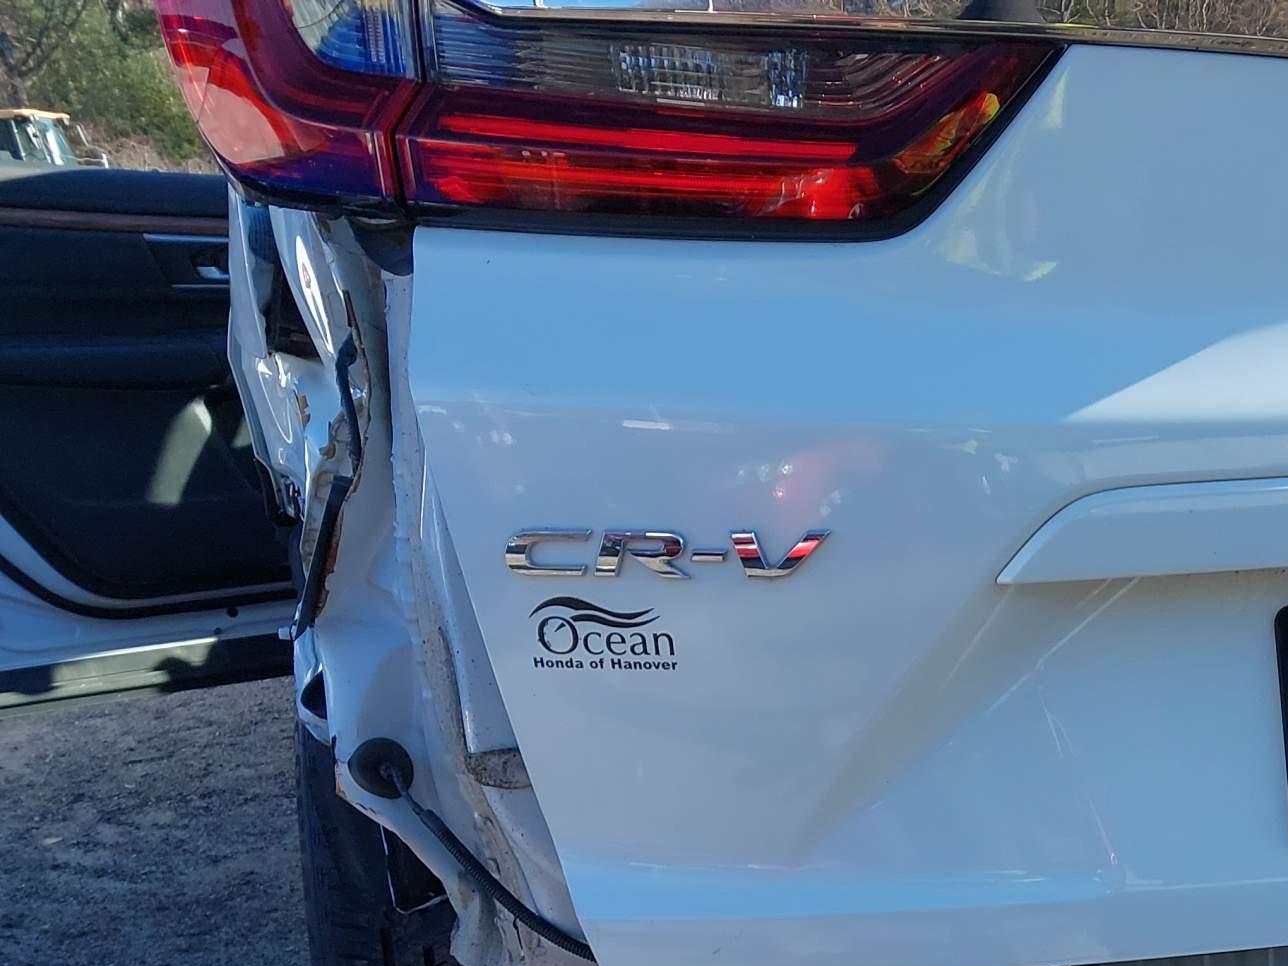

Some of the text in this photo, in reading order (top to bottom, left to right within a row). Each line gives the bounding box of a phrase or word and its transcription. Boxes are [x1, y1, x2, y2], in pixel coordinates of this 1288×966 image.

[504, 529, 832, 579] CR-V
[537, 616, 676, 656] Ocean
[533, 657, 678, 670] Honda of Hanover
